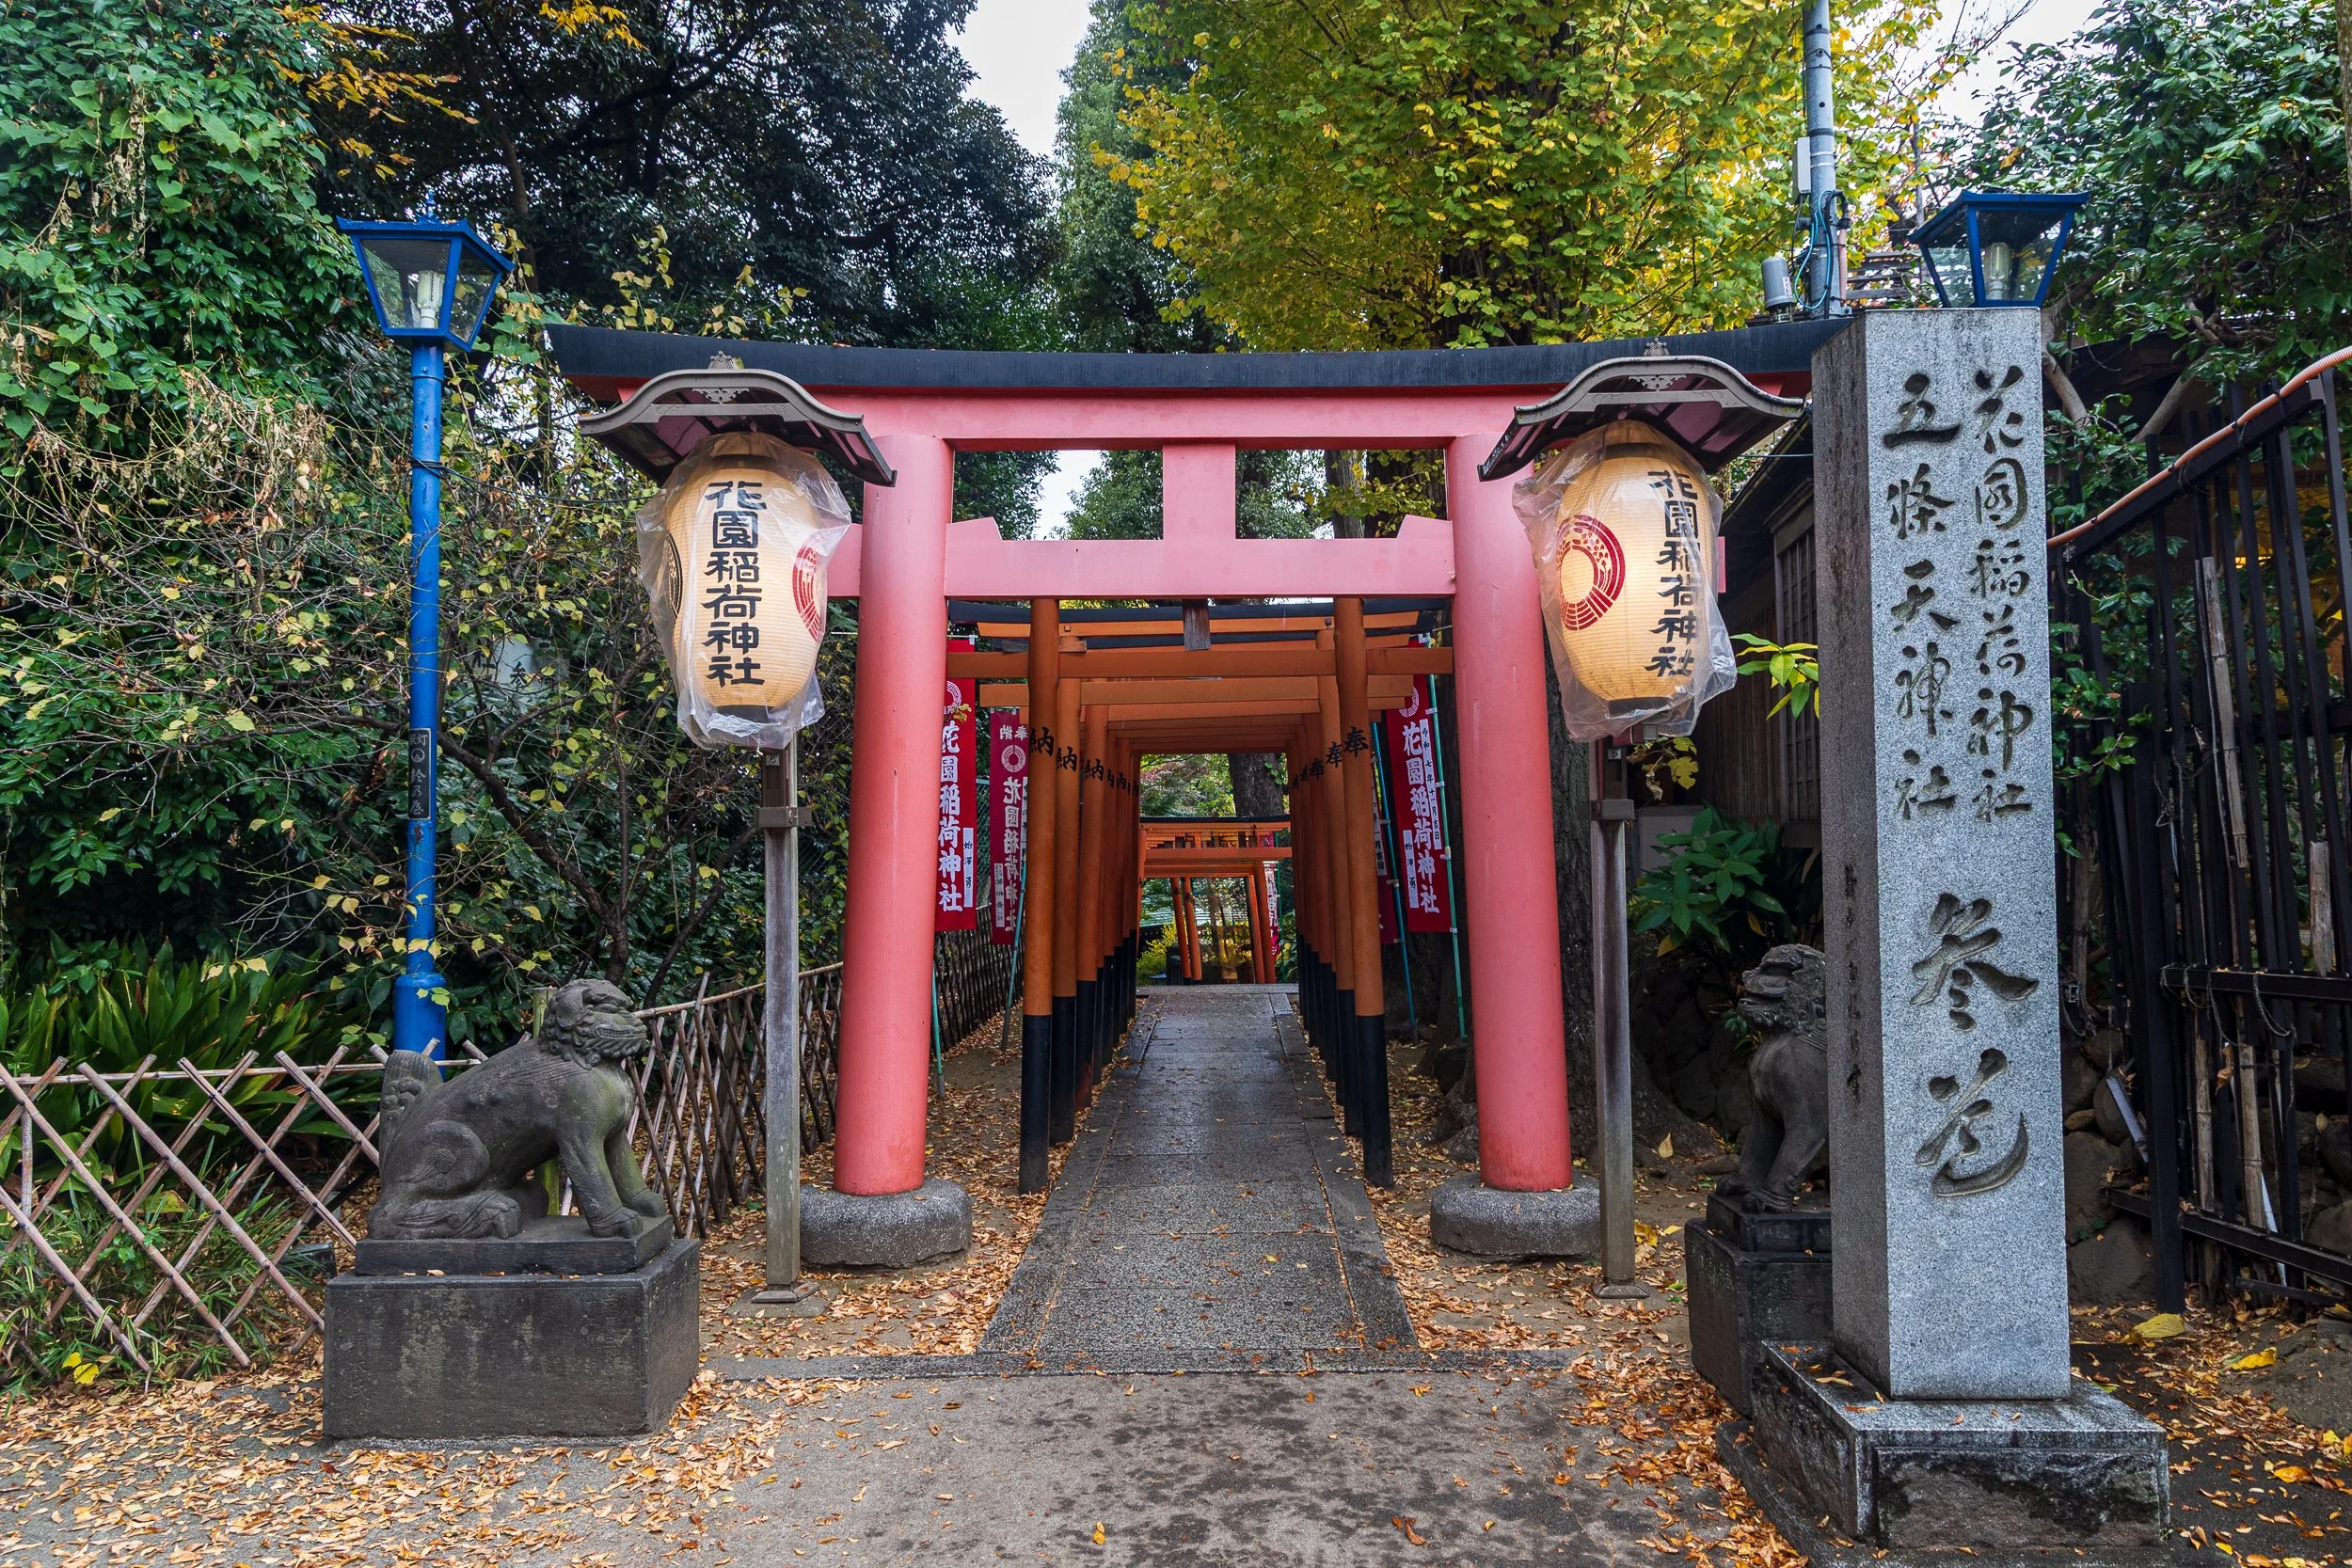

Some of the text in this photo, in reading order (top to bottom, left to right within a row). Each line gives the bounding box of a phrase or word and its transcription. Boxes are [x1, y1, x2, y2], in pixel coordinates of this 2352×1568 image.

[700, 481, 768, 688] 花園稲荷神社
[1028, 726, 1055, 757] 納
[1326, 741, 1343, 768] 奉
[1343, 726, 1369, 758] 奉
[1056, 746, 1077, 772] 納
[938, 720, 962, 912] 花園稲荷神社
[1403, 721, 1439, 913] 花園稲荷神社
